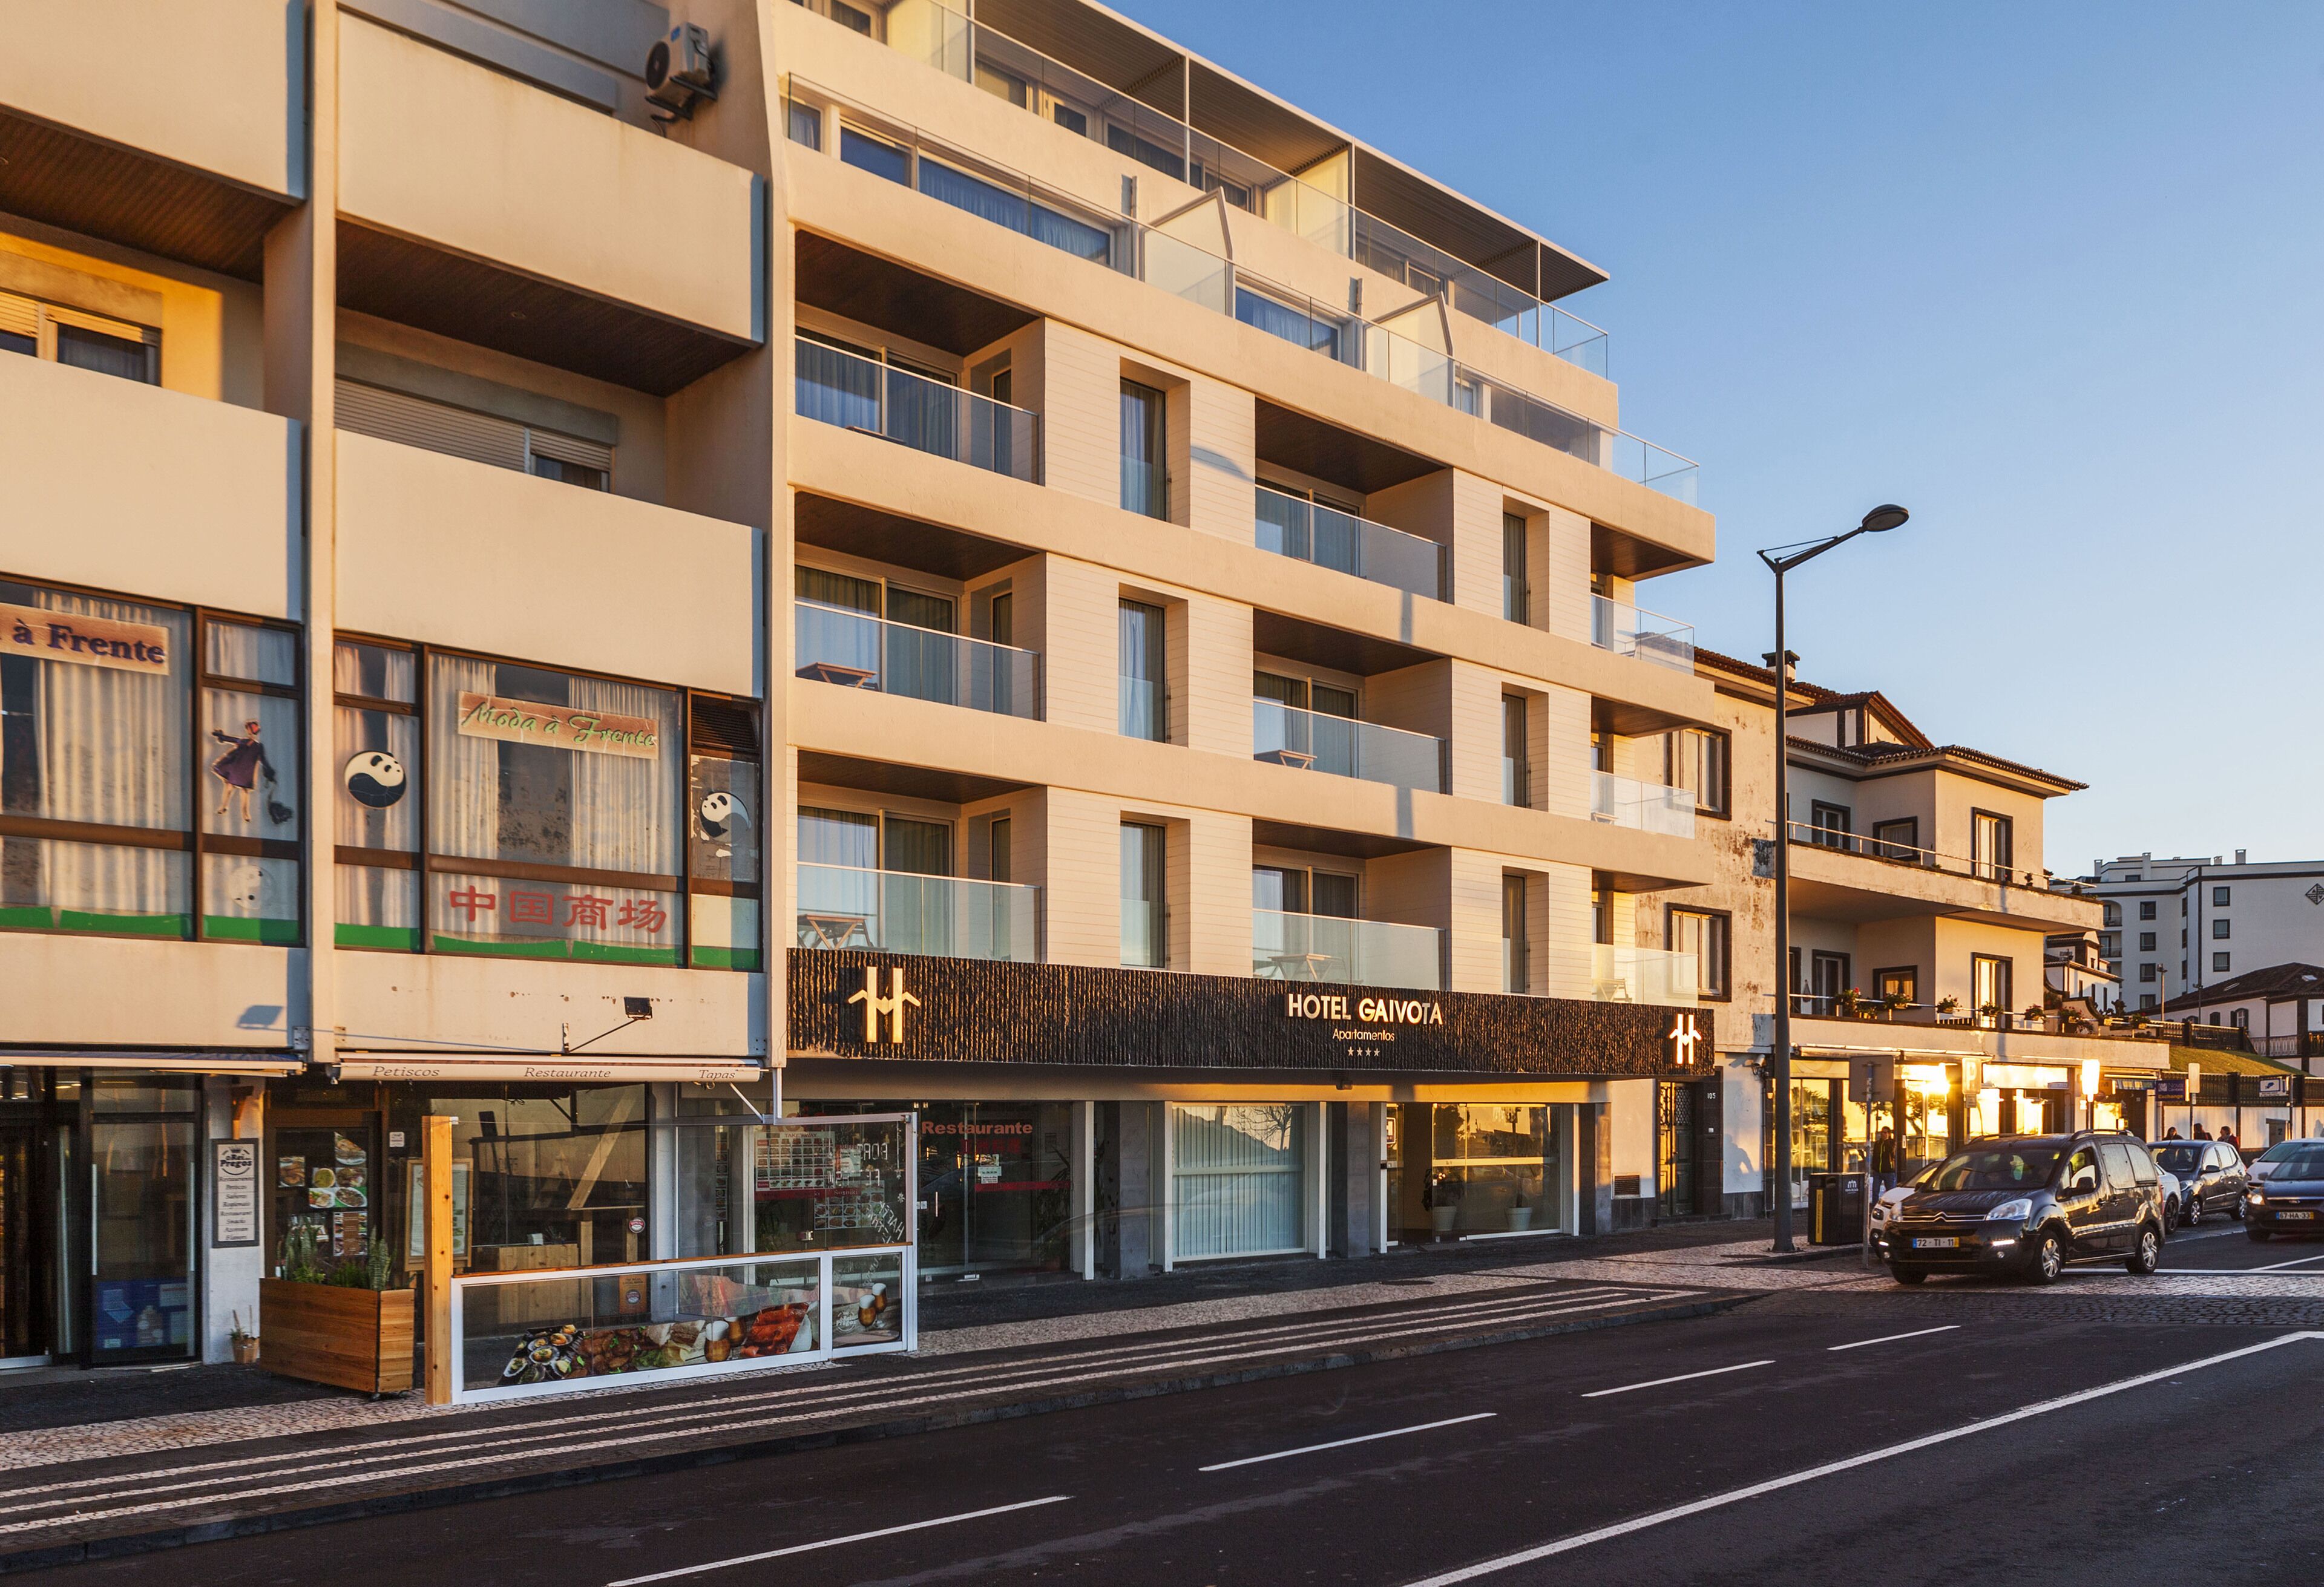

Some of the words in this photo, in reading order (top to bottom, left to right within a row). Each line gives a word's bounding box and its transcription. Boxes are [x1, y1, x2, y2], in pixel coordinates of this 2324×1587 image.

[13, 618, 34, 646] à
[46, 623, 166, 664] Frente
[461, 701, 538, 731] Moda
[543, 715, 561, 734] à
[568, 714, 656, 747] Frente
[450, 885, 667, 934] 中国商场
[1288, 993, 1351, 1020] HOTEL
[1359, 998, 1443, 1025] GAIVOTA
[1332, 1028, 1396, 1042] Apartamentos
[372, 1066, 440, 1076] Petiscos
[524, 1067, 611, 1078] Restaurante
[699, 1070, 736, 1081] Tapas
[921, 1121, 1033, 1134] Restaurante
[220, 1160, 252, 1168] Pregos
